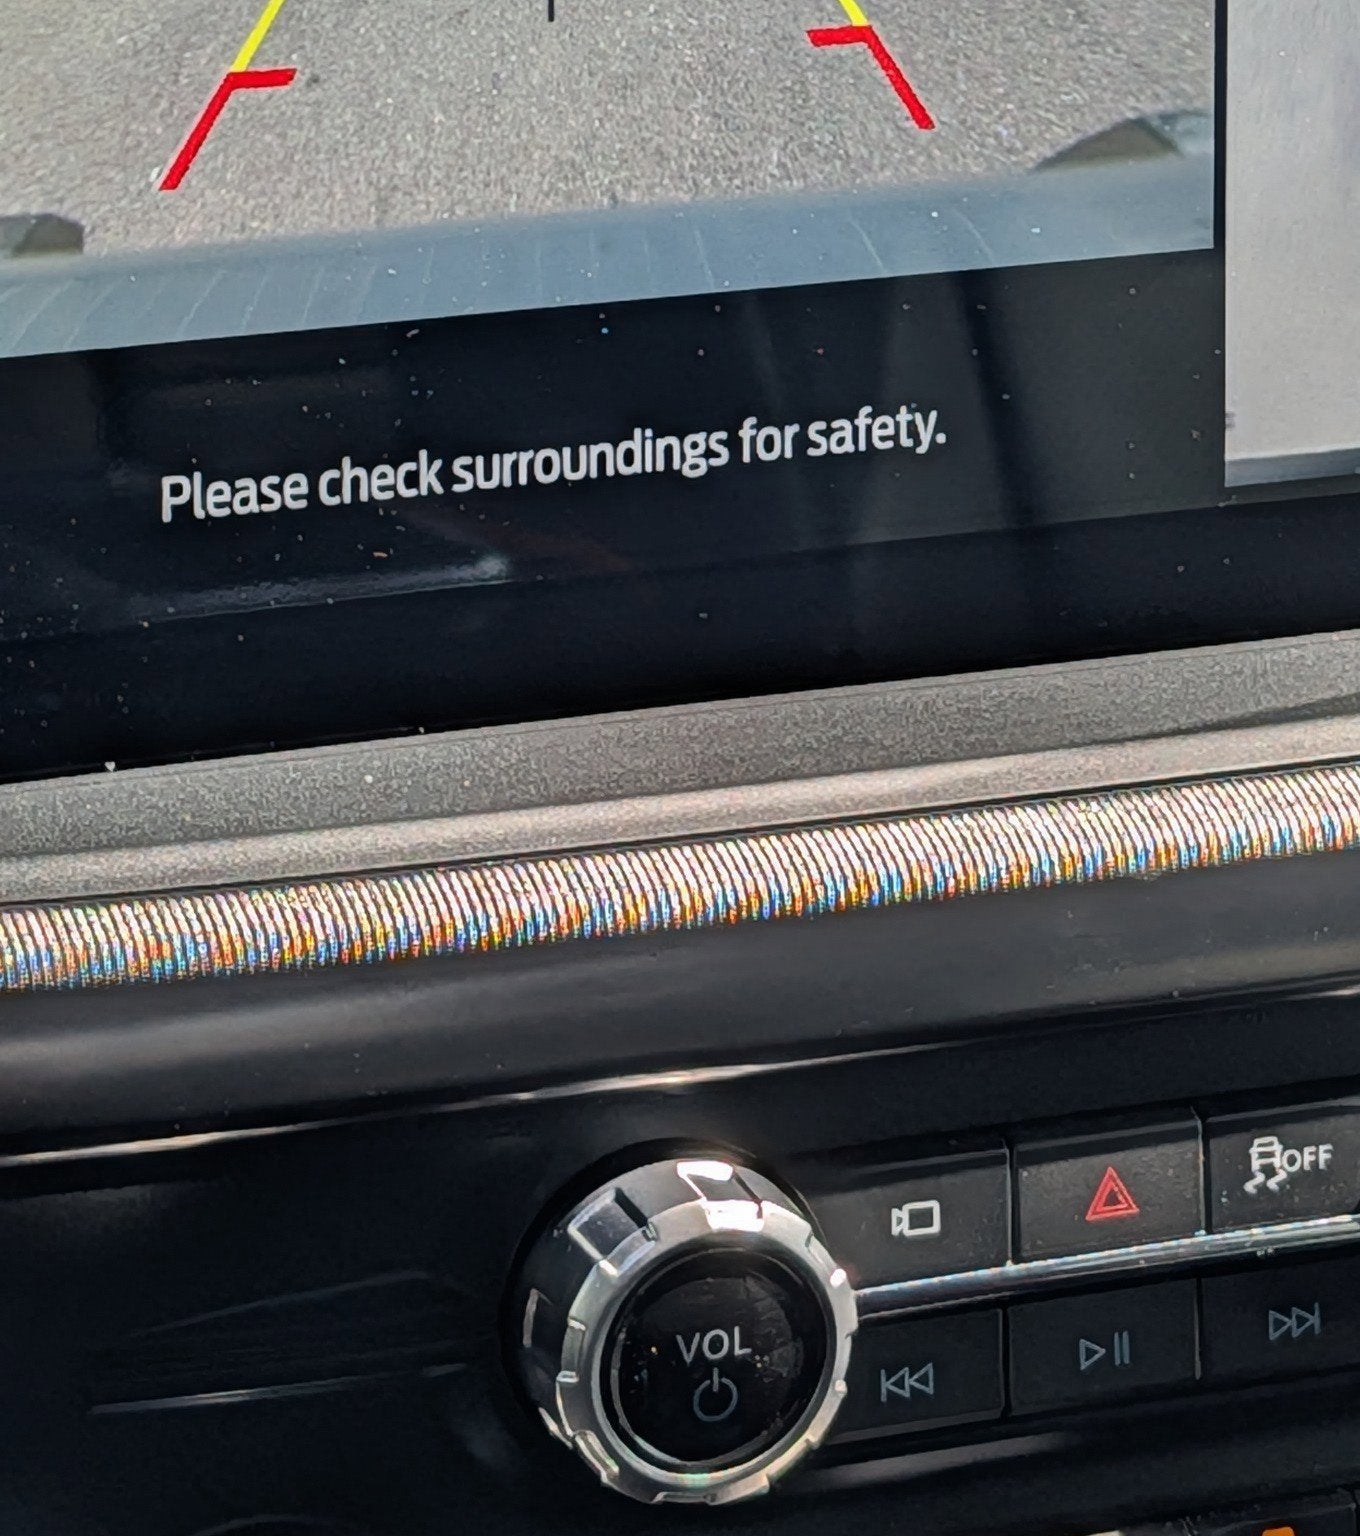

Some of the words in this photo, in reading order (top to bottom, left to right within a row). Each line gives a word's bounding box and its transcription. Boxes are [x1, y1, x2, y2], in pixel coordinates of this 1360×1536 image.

[160, 470, 309, 524] Please
[318, 448, 445, 507] check
[450, 427, 731, 494] surroundings
[738, 416, 801, 464] for
[806, 404, 948, 458] safety.
[1281, 1143, 1334, 1173] OFF
[675, 1325, 752, 1365] VOL
